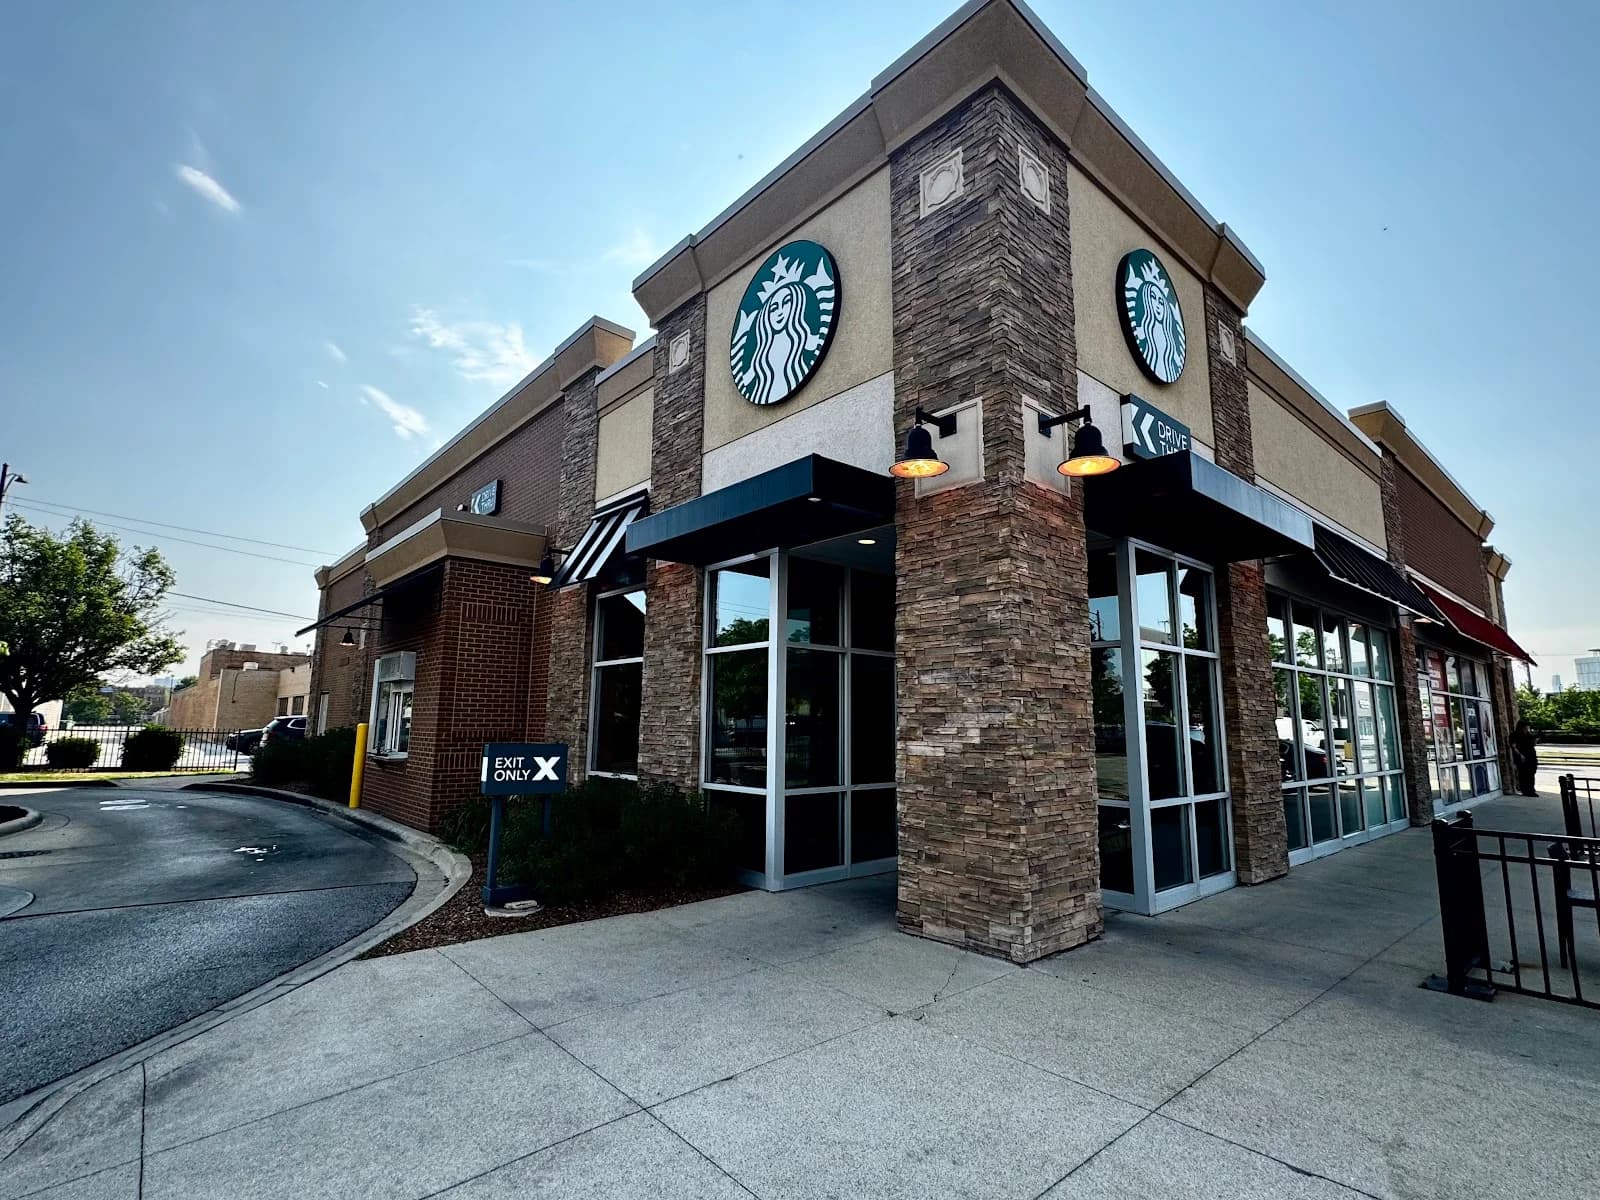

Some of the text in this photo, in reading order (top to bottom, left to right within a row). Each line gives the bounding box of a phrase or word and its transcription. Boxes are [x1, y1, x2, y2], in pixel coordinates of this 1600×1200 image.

[1158, 421, 1187, 450] DRIVE
[495, 757, 525, 768] EXIT
[494, 770, 531, 782] ONLY
